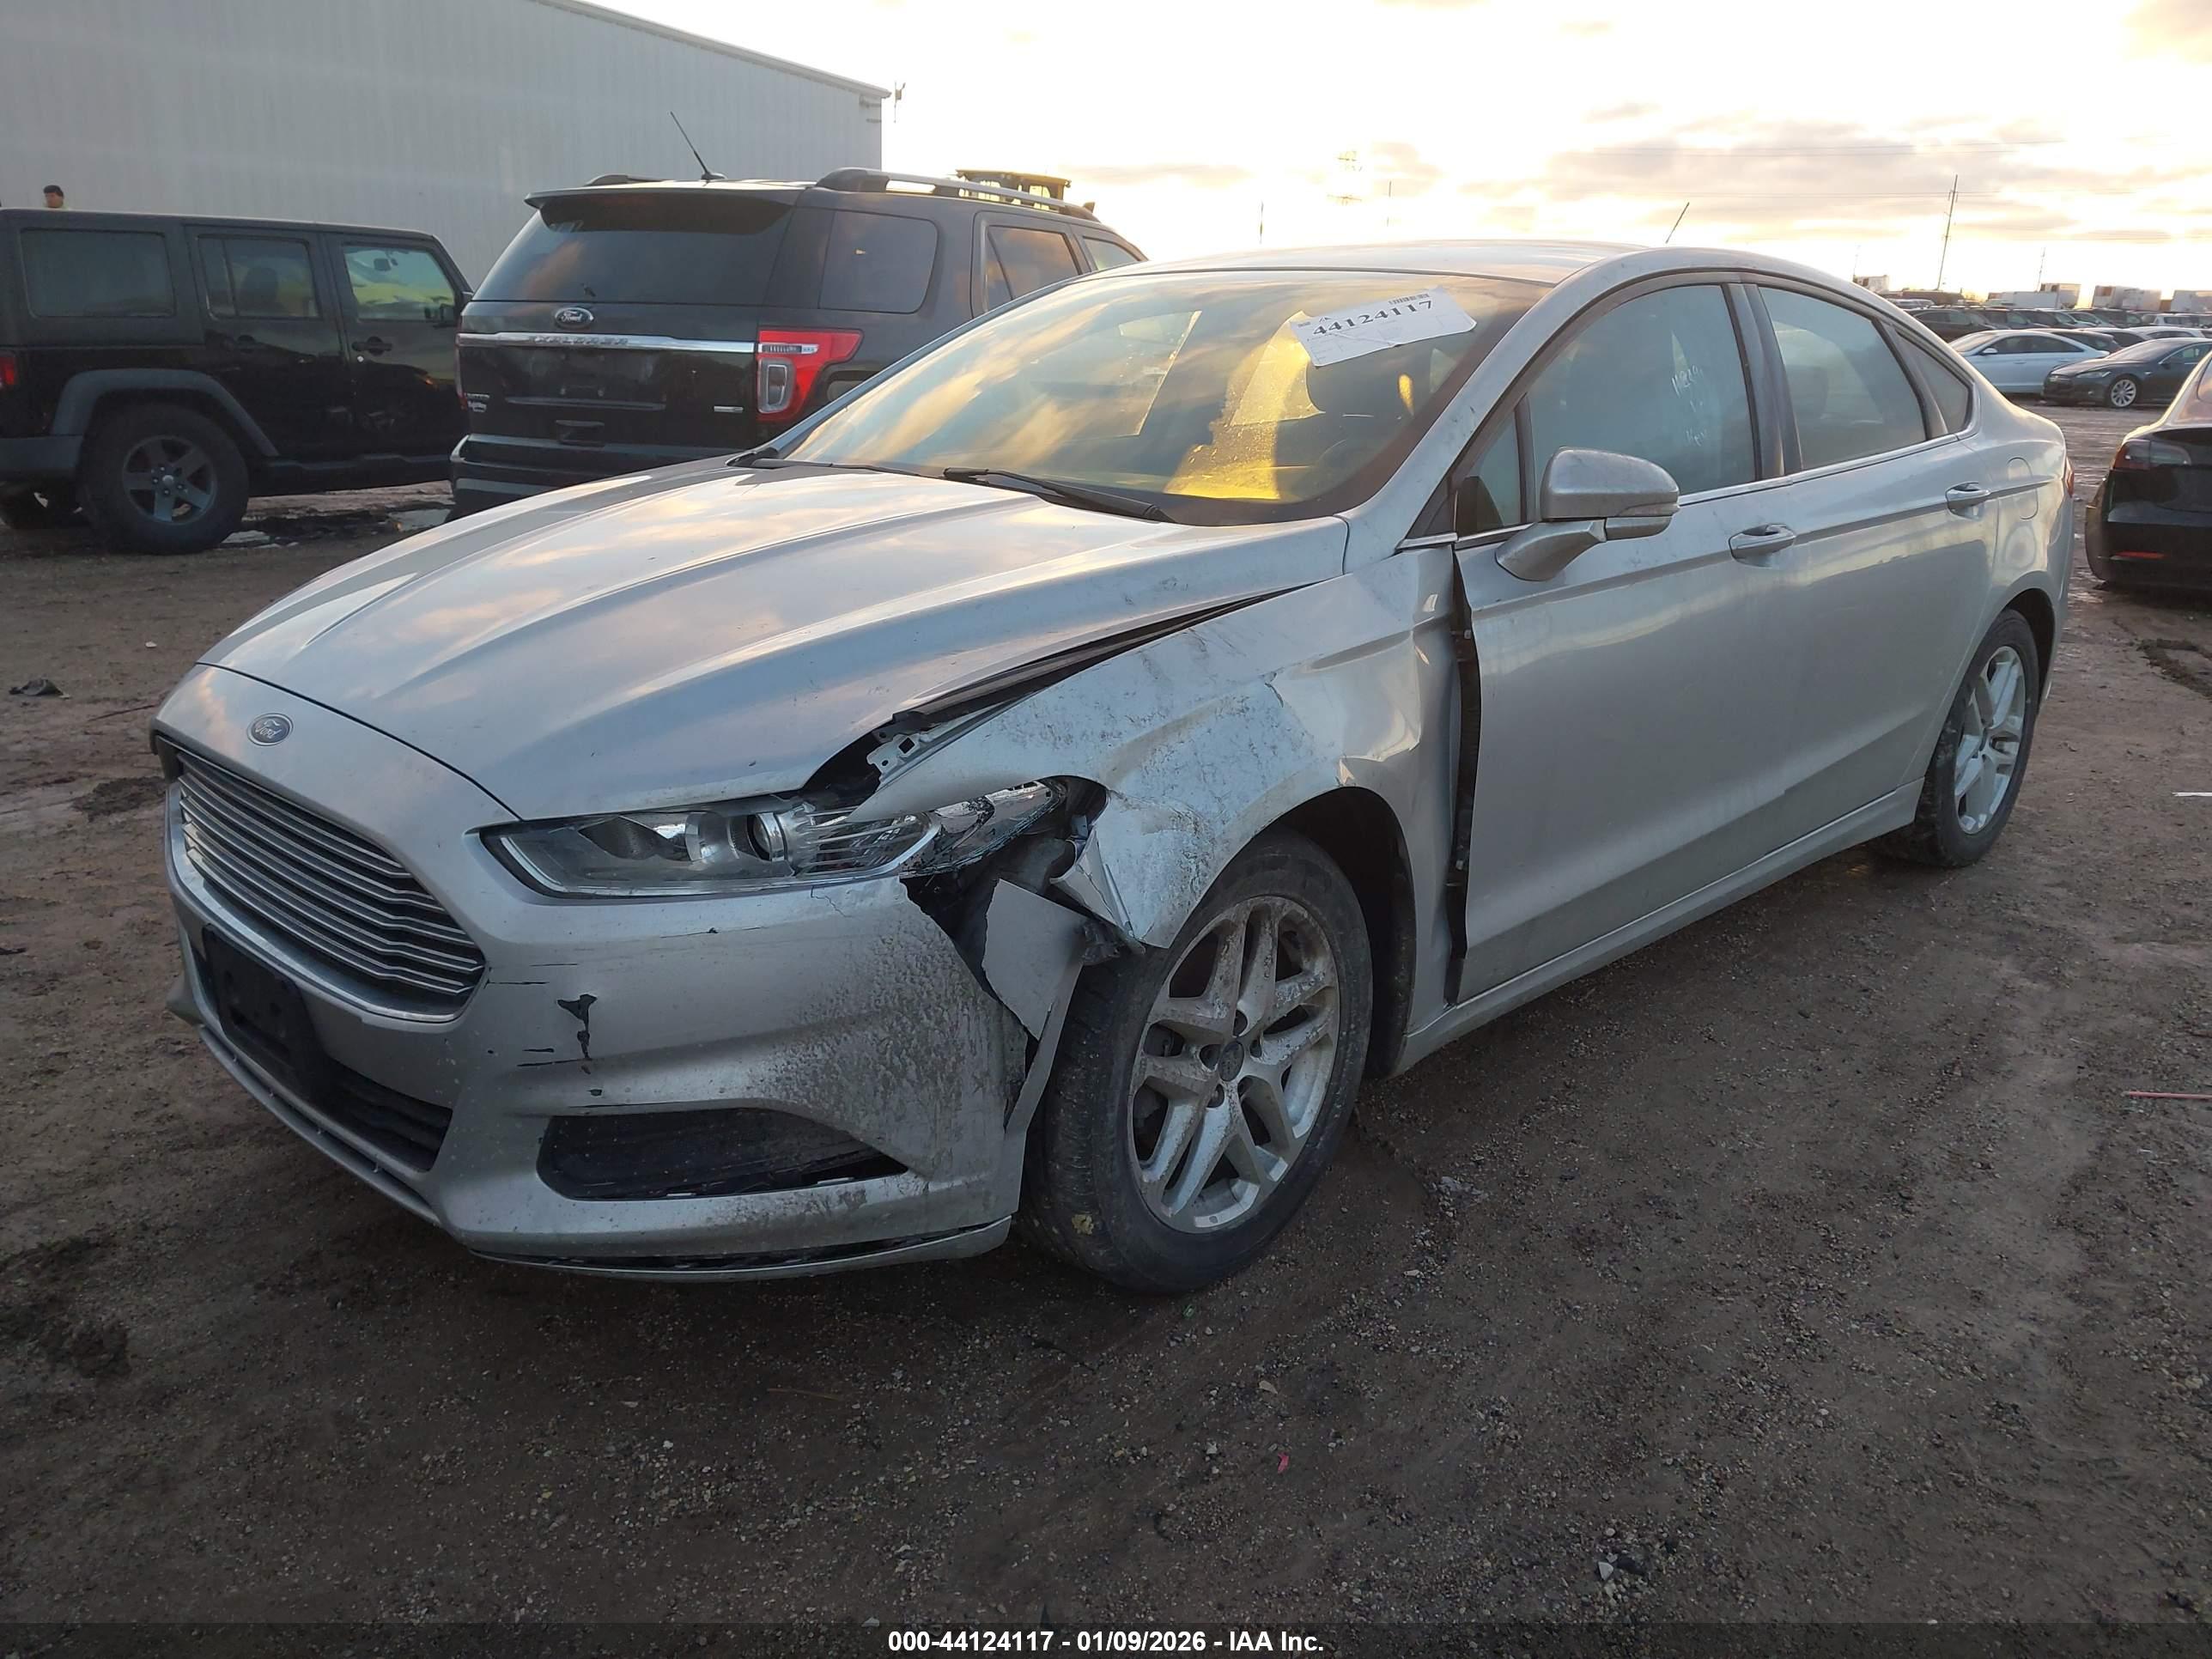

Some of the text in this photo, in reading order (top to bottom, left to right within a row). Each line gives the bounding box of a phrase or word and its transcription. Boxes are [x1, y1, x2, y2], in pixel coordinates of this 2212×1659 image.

[559, 310, 584, 323] Ford
[1313, 300, 1432, 335] 44124117
[255, 719, 283, 738] Ford
